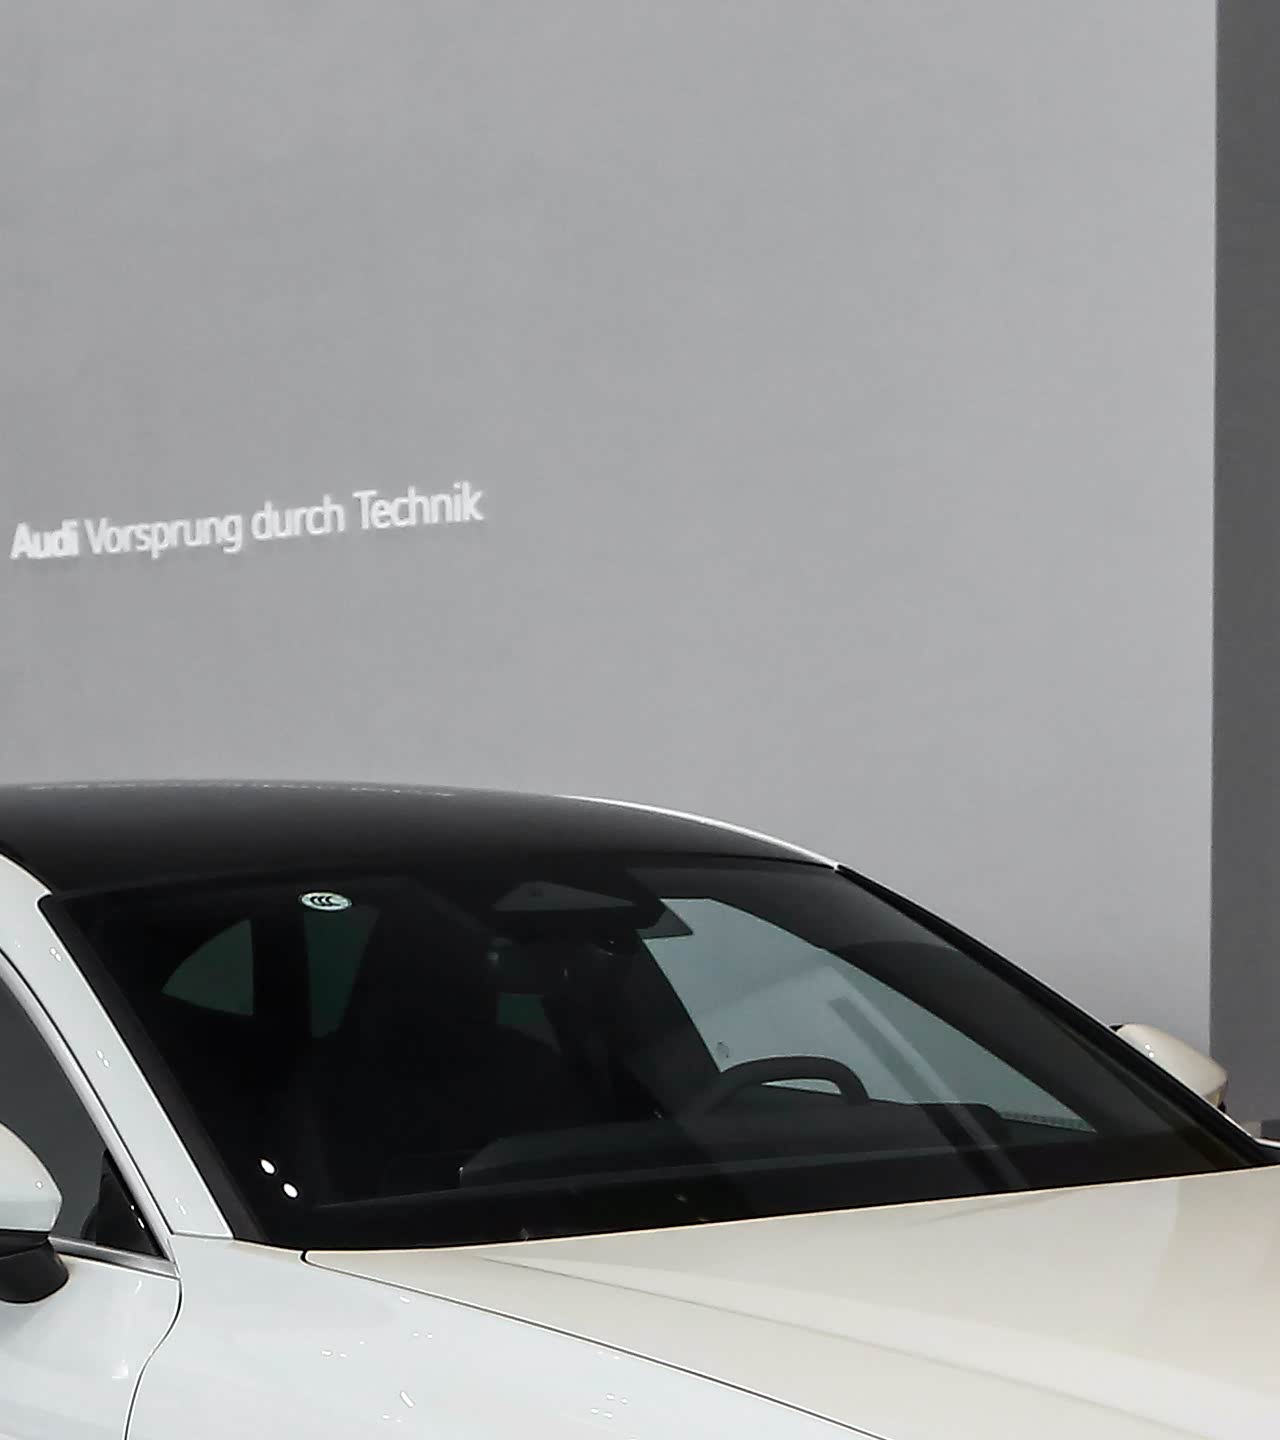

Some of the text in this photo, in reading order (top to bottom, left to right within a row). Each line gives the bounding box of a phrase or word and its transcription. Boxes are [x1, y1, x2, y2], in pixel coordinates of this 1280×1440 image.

[10, 481, 484, 560] Audi Vorsprung durch Technik
